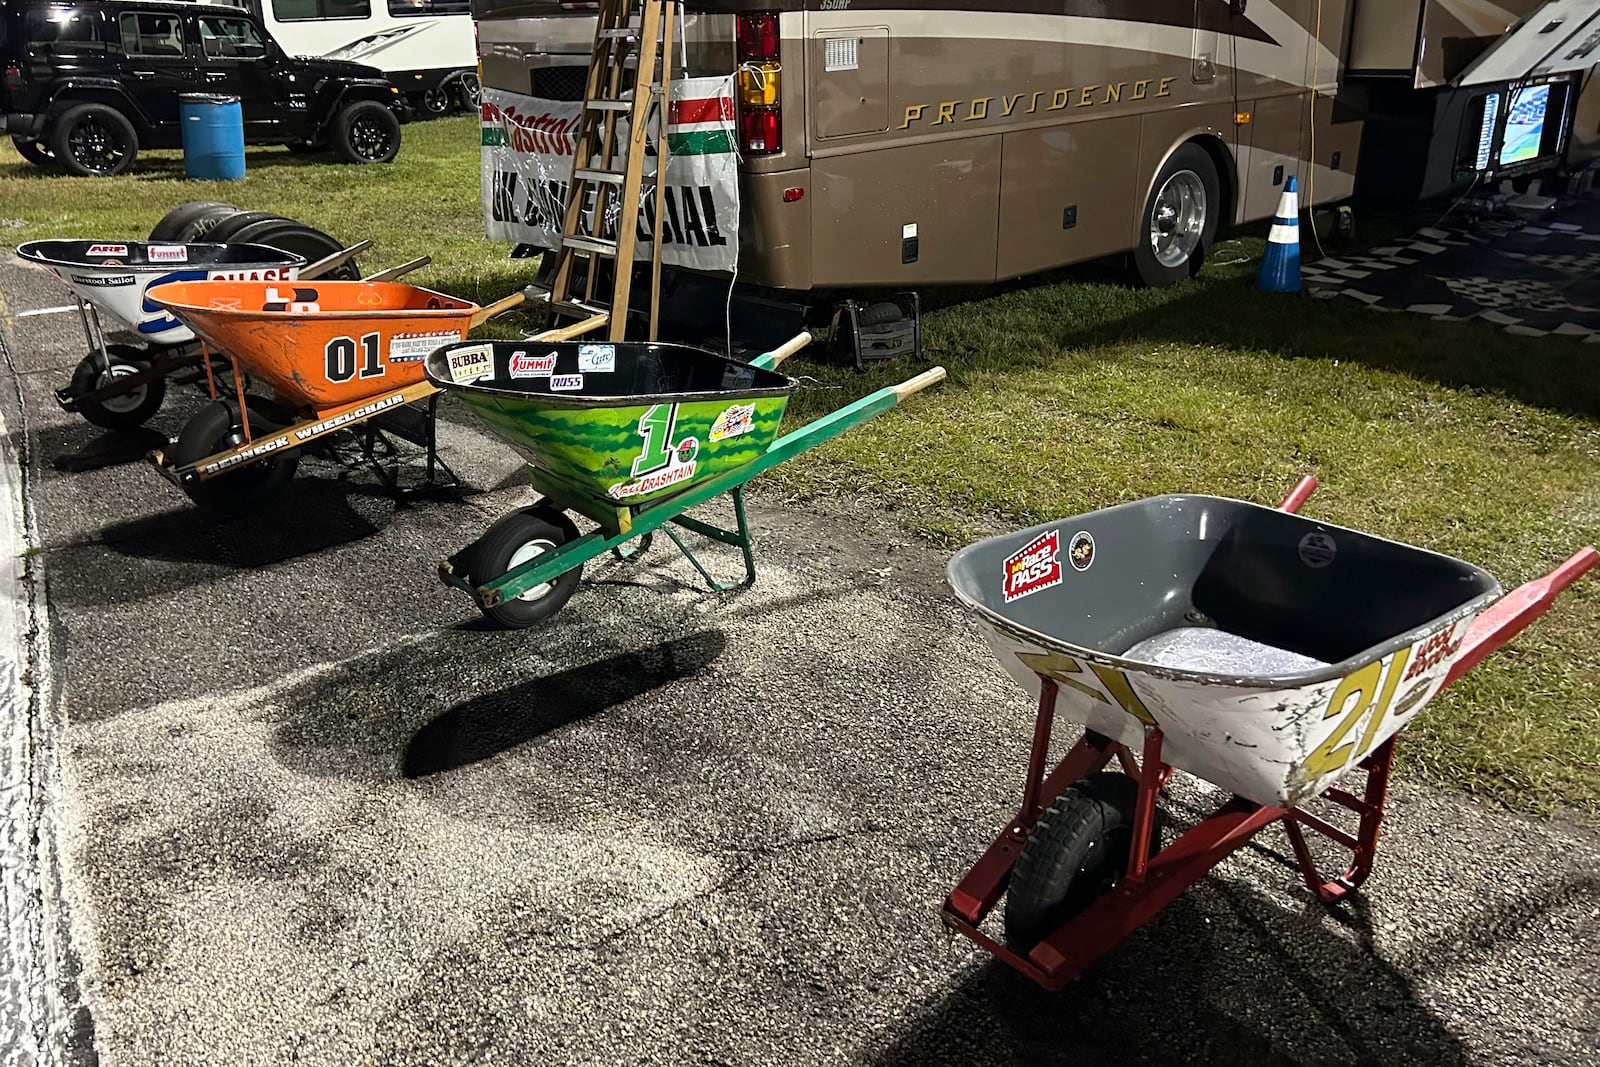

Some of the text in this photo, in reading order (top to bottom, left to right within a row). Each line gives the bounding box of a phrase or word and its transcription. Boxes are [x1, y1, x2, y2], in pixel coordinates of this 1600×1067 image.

[896, 75, 1178, 130] PROVIDENCE
[500, 104, 583, 157] Castrol
[91, 245, 126, 254] ARP
[107, 276, 136, 285] Sailor
[325, 330, 386, 384] 01
[451, 351, 488, 369] BUBBA
[205, 393, 405, 474] REDNECK WHEELCHAIR
[640, 462, 695, 493] CRASHTAIN
[1010, 556, 1053, 592] PASS
[1290, 646, 1412, 784] 21
